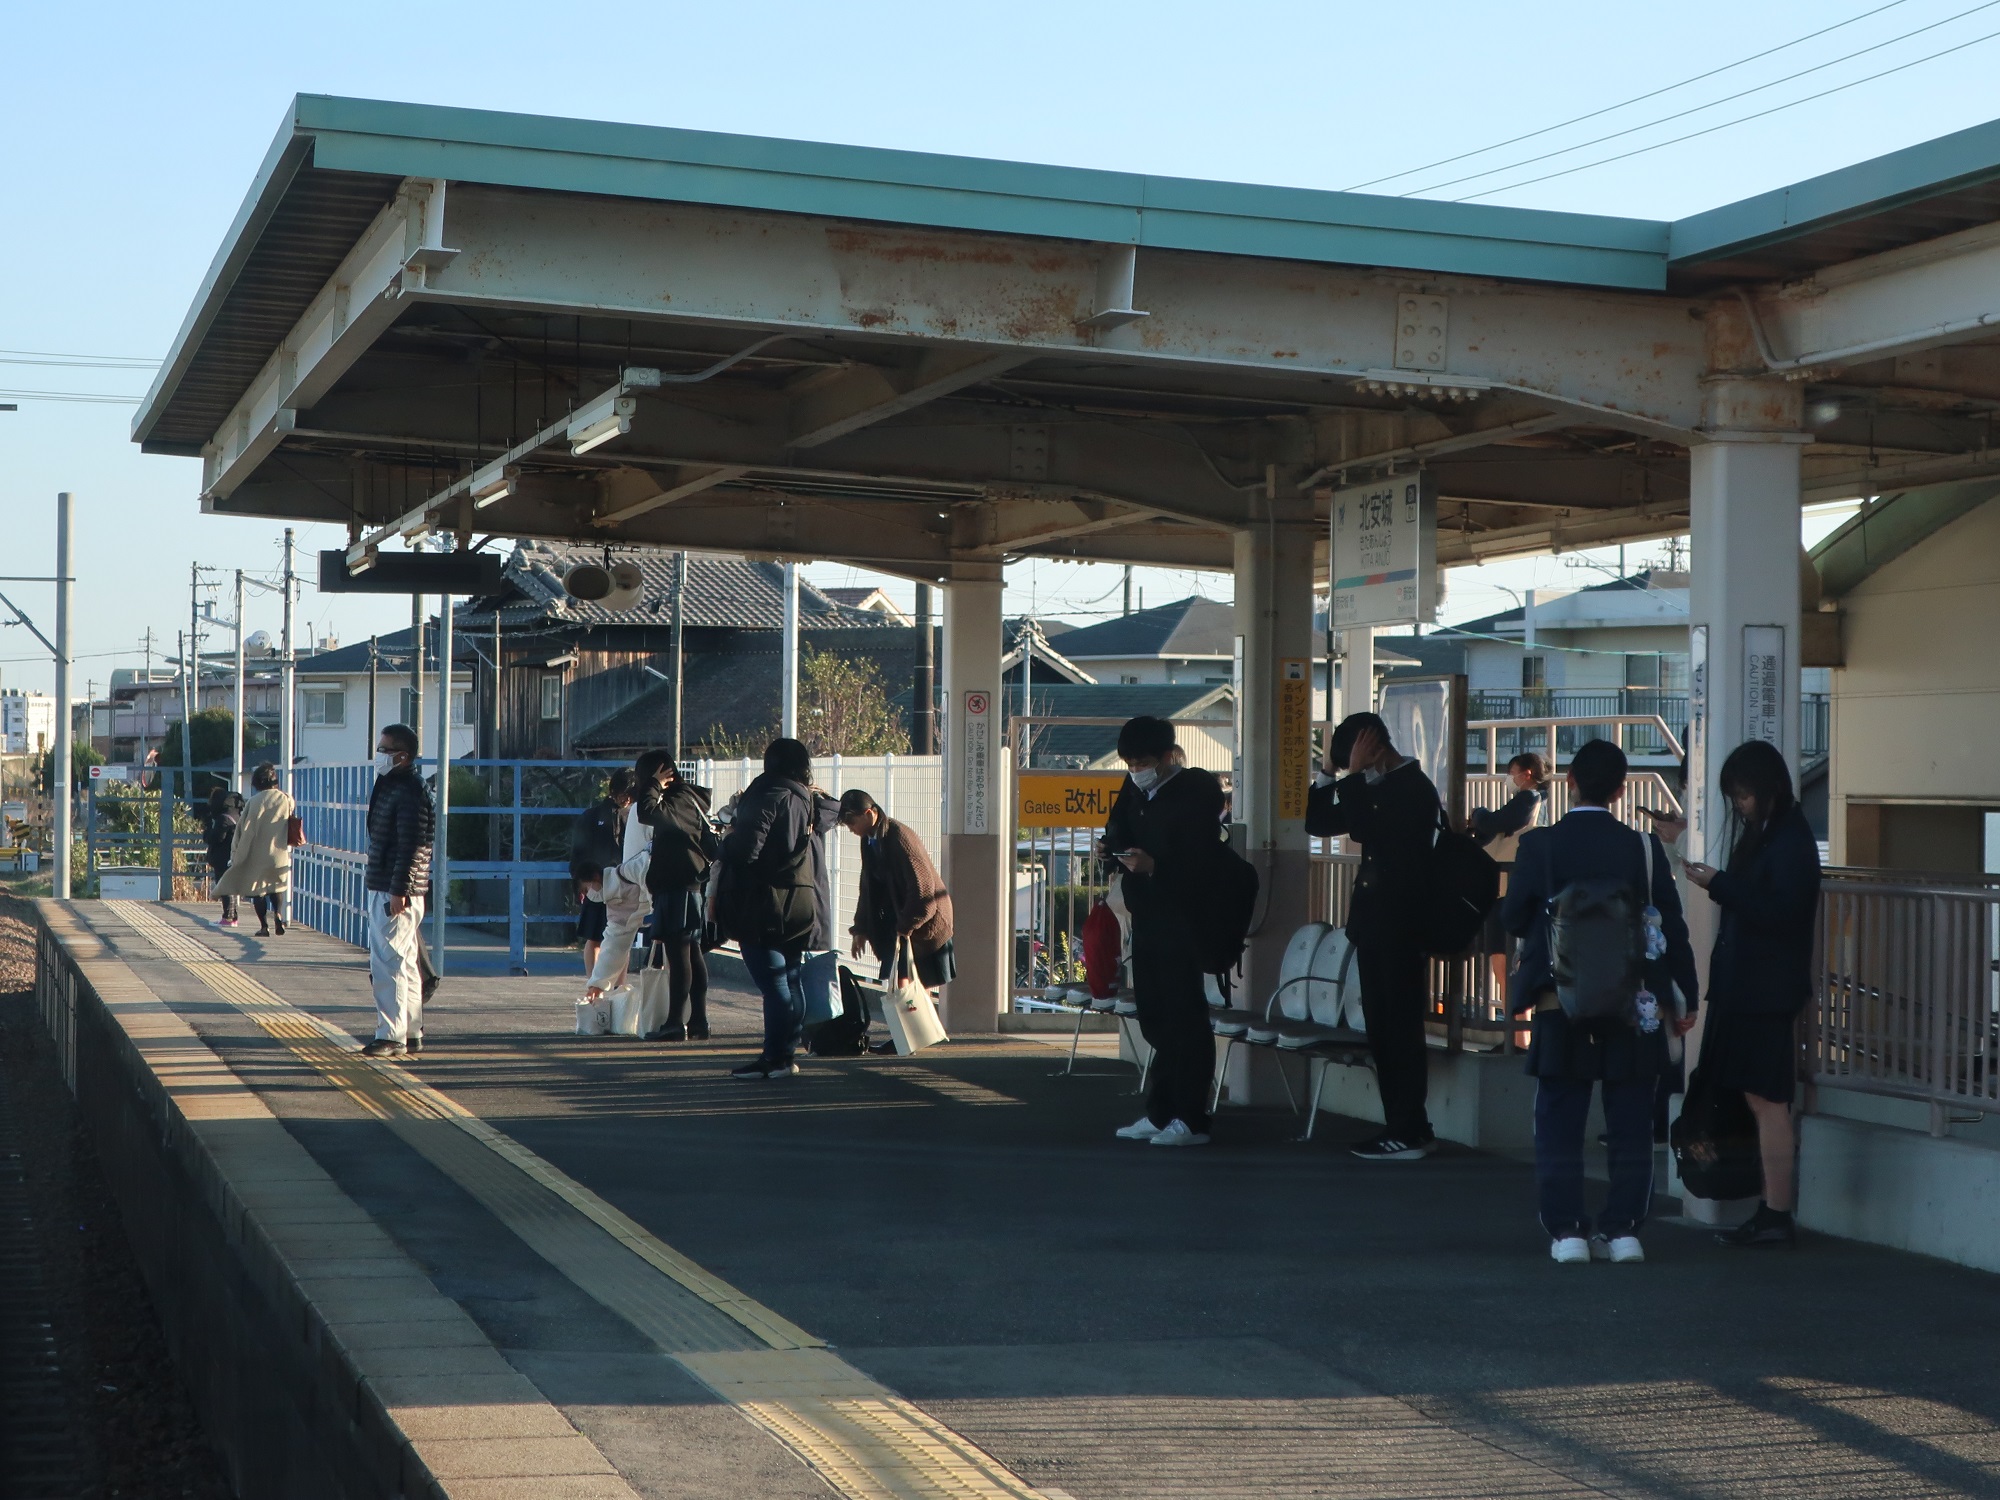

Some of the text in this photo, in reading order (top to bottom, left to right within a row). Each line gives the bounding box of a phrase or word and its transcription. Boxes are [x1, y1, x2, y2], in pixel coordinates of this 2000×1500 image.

[1360, 489, 1393, 531] 北安城
[975, 722, 985, 828] かけこみ乗車はおやめください
[1294, 683, 1305, 817] インターホン Intercom
[1024, 799, 1061, 815] Gates
